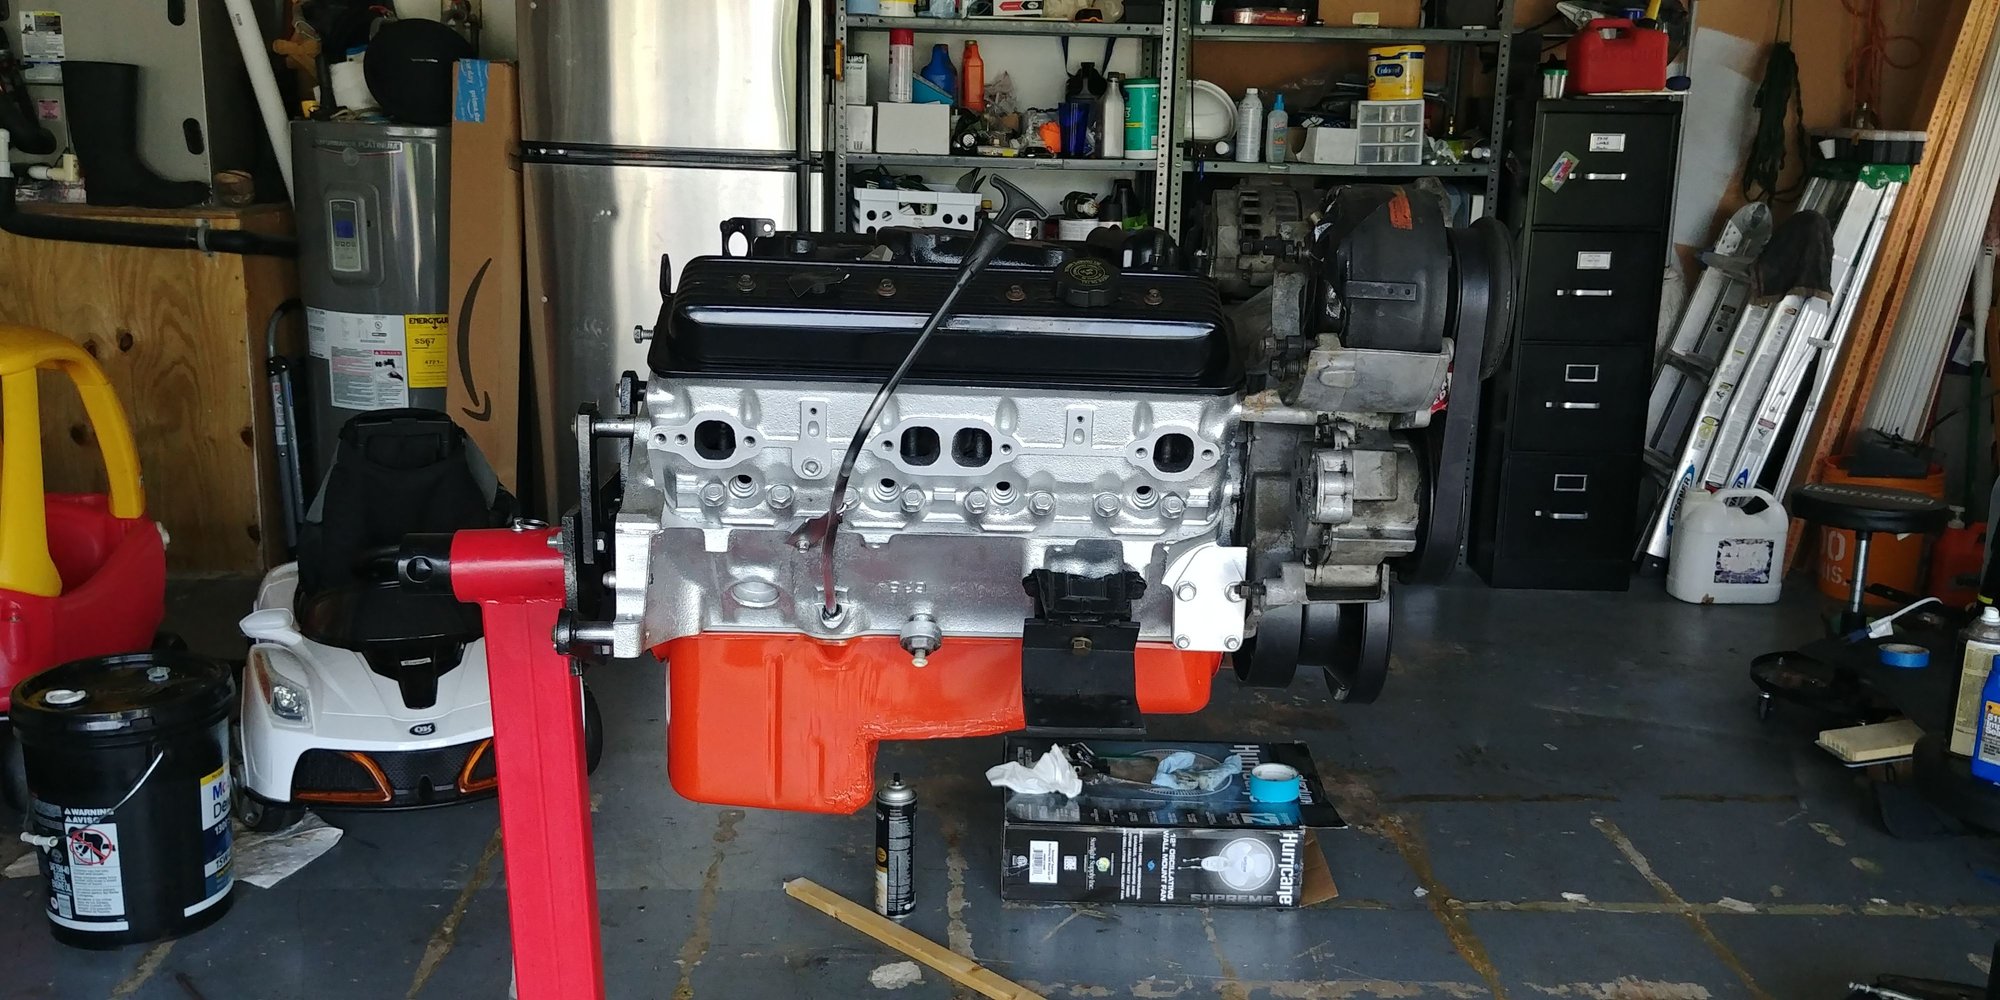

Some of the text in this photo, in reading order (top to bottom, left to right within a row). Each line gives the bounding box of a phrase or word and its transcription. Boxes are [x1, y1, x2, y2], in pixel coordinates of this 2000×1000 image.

[71, 808, 115, 816] WARNING
[1088, 837, 1097, 860] Sunlight
[1159, 830, 1169, 901] WALL MOUNT FAN
[1167, 848, 1176, 900] OSCILLATING
[1276, 833, 1299, 906] Hurricane
[1189, 893, 1274, 903] SUPREME
